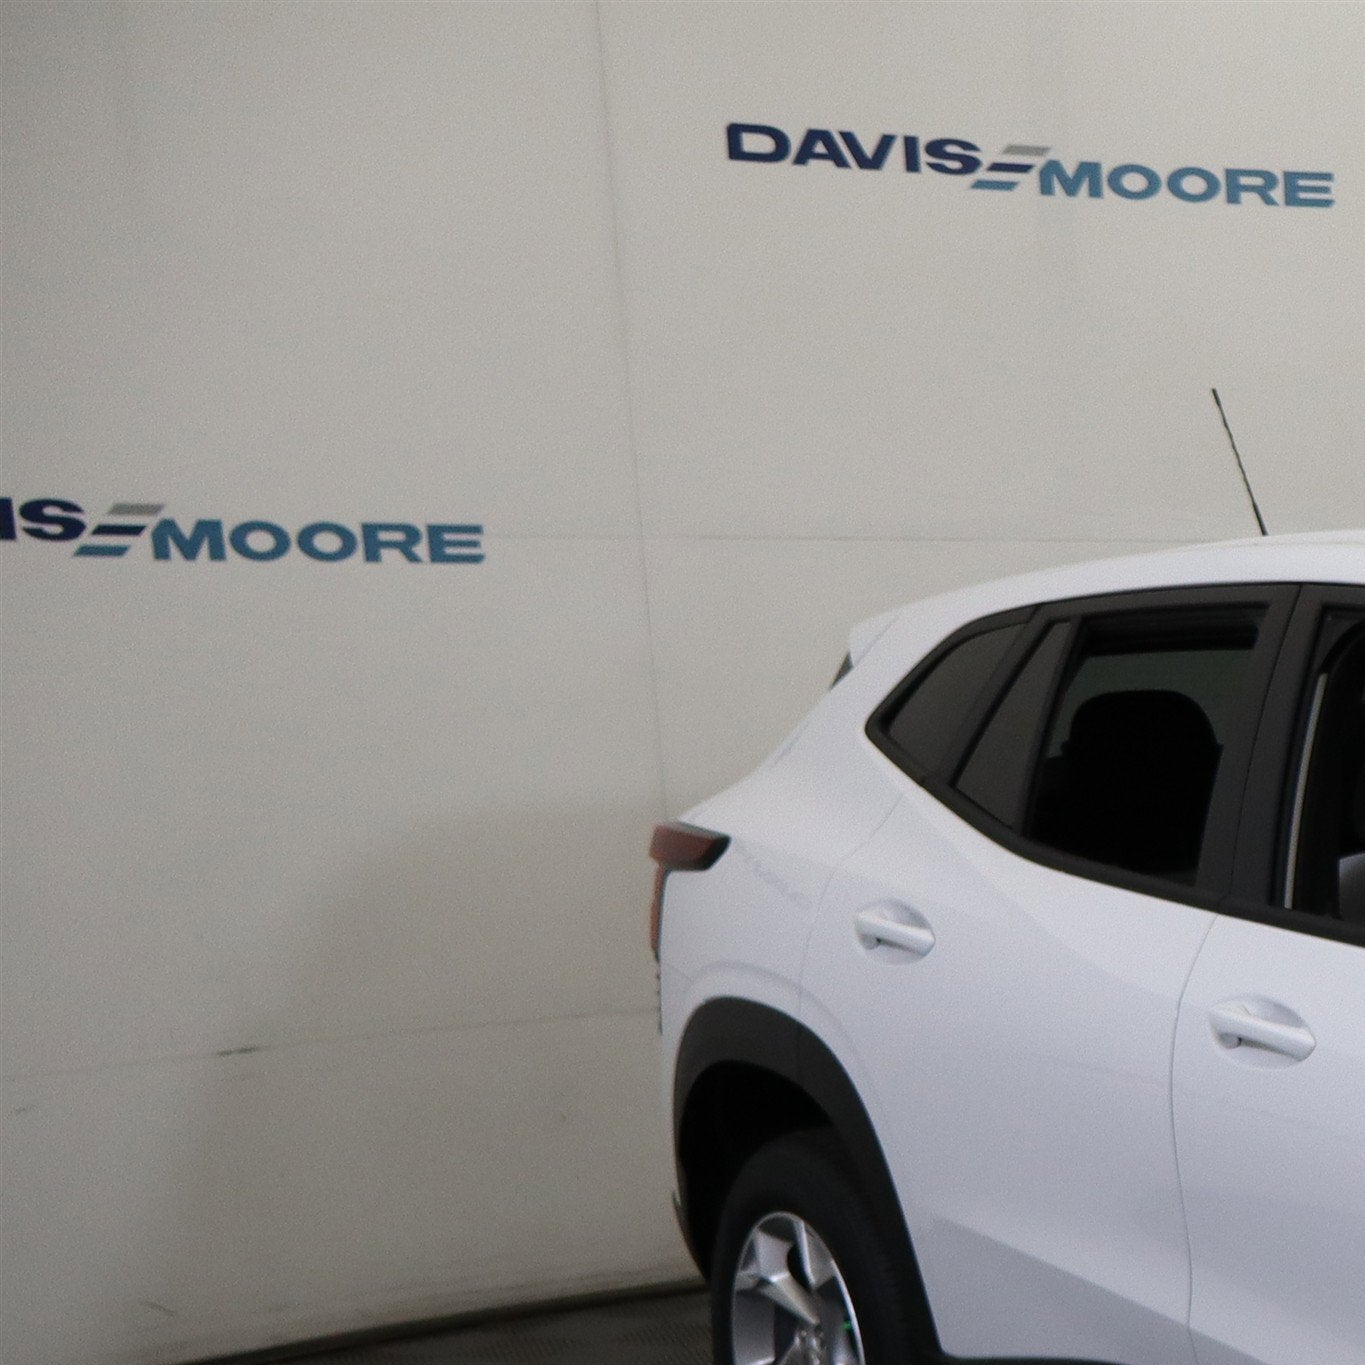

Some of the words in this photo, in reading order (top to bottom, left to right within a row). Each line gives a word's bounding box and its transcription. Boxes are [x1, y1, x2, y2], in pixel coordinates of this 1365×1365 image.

[727, 122, 982, 176] DAVIS
[1039, 158, 1336, 209] MOORE
[151, 516, 487, 564] MOORE
